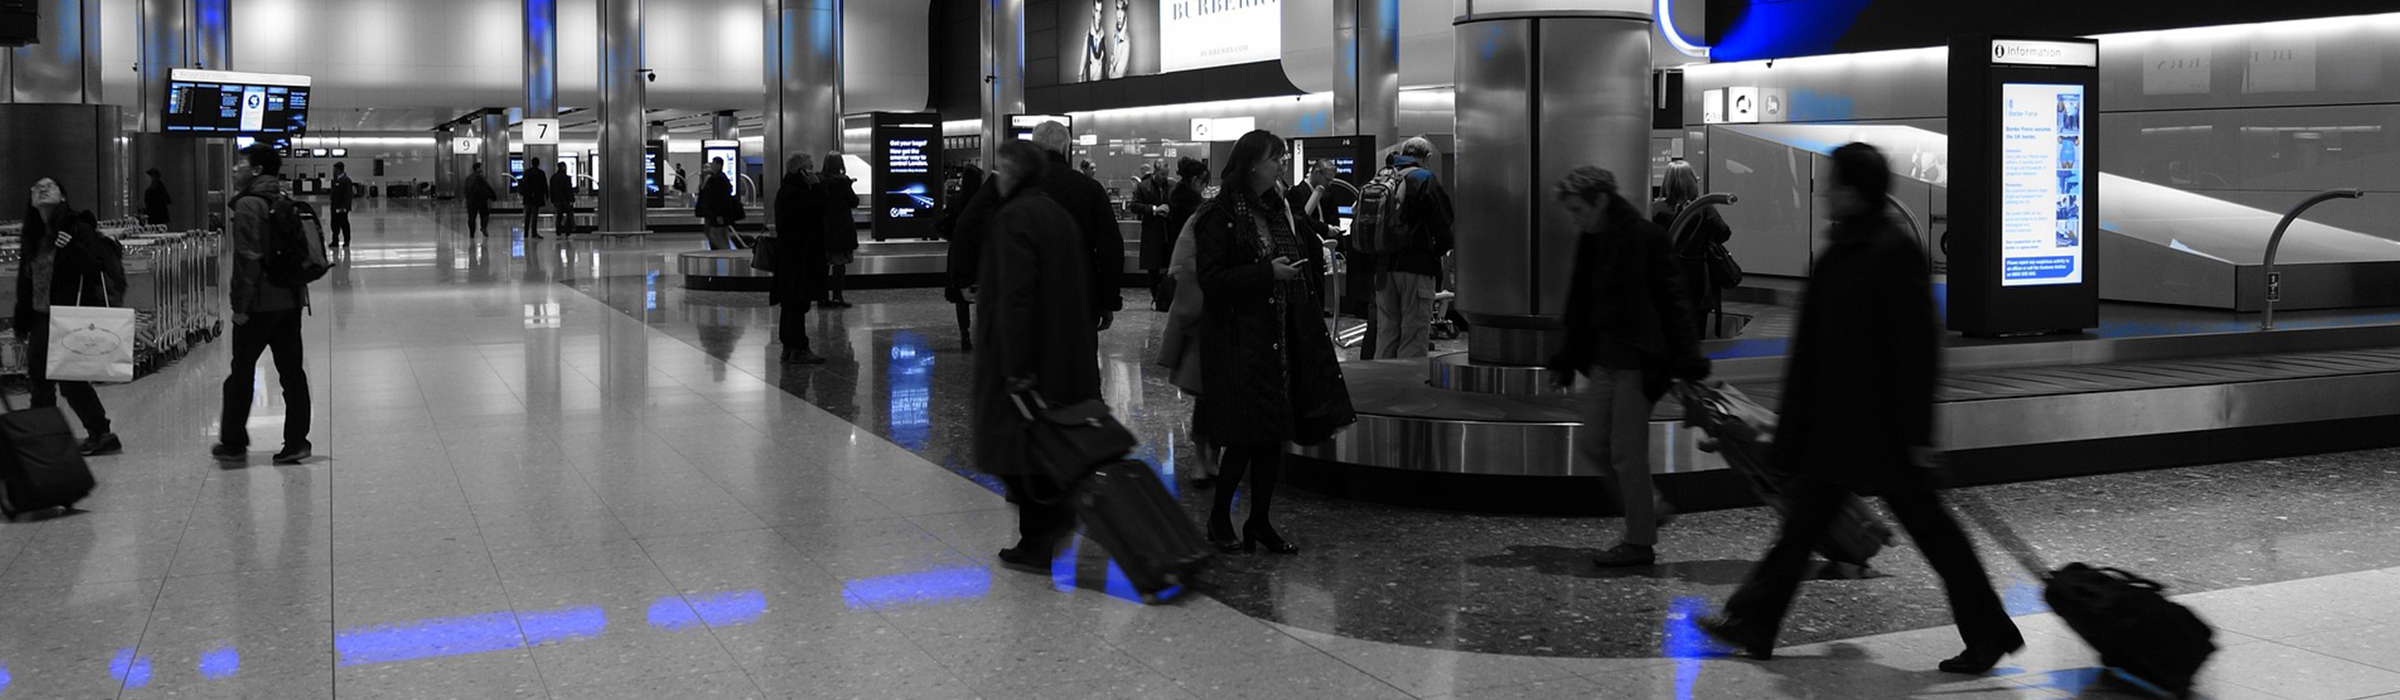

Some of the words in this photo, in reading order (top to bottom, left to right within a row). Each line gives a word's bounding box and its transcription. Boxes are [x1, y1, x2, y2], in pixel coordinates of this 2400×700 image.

[2007, 46, 2061, 57] Information
[537, 123, 548, 139] 7
[463, 140, 470, 150] 9
